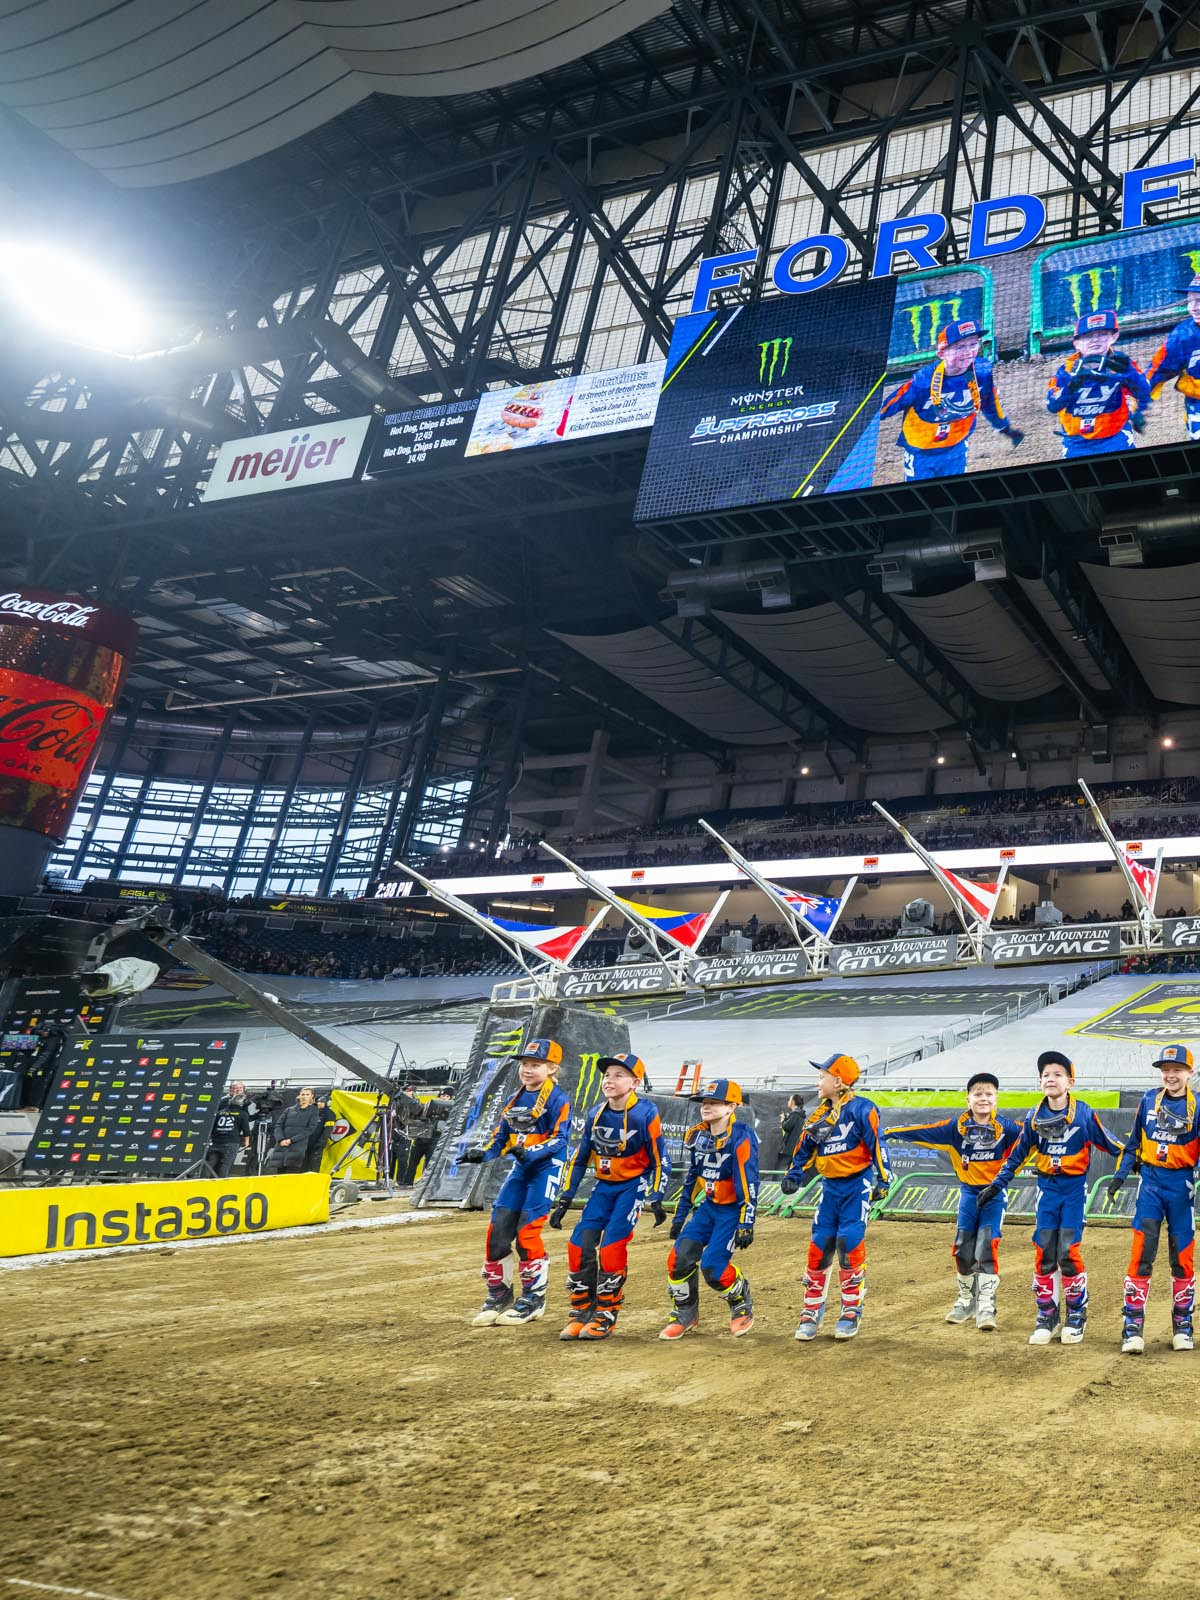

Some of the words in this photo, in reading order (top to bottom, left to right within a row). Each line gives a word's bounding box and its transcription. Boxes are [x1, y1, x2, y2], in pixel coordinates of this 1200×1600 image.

[690, 193, 1048, 314] FORD
[730, 385, 804, 407] MONSTER
[740, 399, 792, 413] ENERGY
[390, 426, 403, 436] Hot
[419, 420, 439, 431] Chips
[446, 416, 464, 426] Soda
[689, 400, 840, 439] SUPERCROSS
[700, 415, 717, 424] AMA
[414, 430, 433, 442] 12.49
[719, 422, 803, 444] CHAMPIONSHIP
[383, 448, 397, 458] Hot
[413, 442, 433, 453] Chips
[440, 438, 458, 448] Beer
[227, 433, 346, 483] meijer
[407, 452, 426, 464] 14.49
[374, 882, 395, 898] 2:38
[396, 881, 414, 897] PM
[1010, 932, 1044, 944] ROCKY
[1047, 929, 1111, 942] MOUNTAIN
[855, 945, 890, 956] ROCKY
[892, 939, 948, 953] MOUNTAIN
[710, 957, 742, 968] ROCKY
[742, 952, 800, 964] MOUNTAIN
[579, 971, 611, 982] ROCKY
[613, 967, 665, 979] MOUNTAIN
[1151, 1130, 1178, 1142] KTM
[824, 1142, 847, 1155] KTM
[970, 1151, 996, 1160] KTM
[694, 1151, 731, 1169] FLY
[45, 1192, 269, 1249] Insta360
